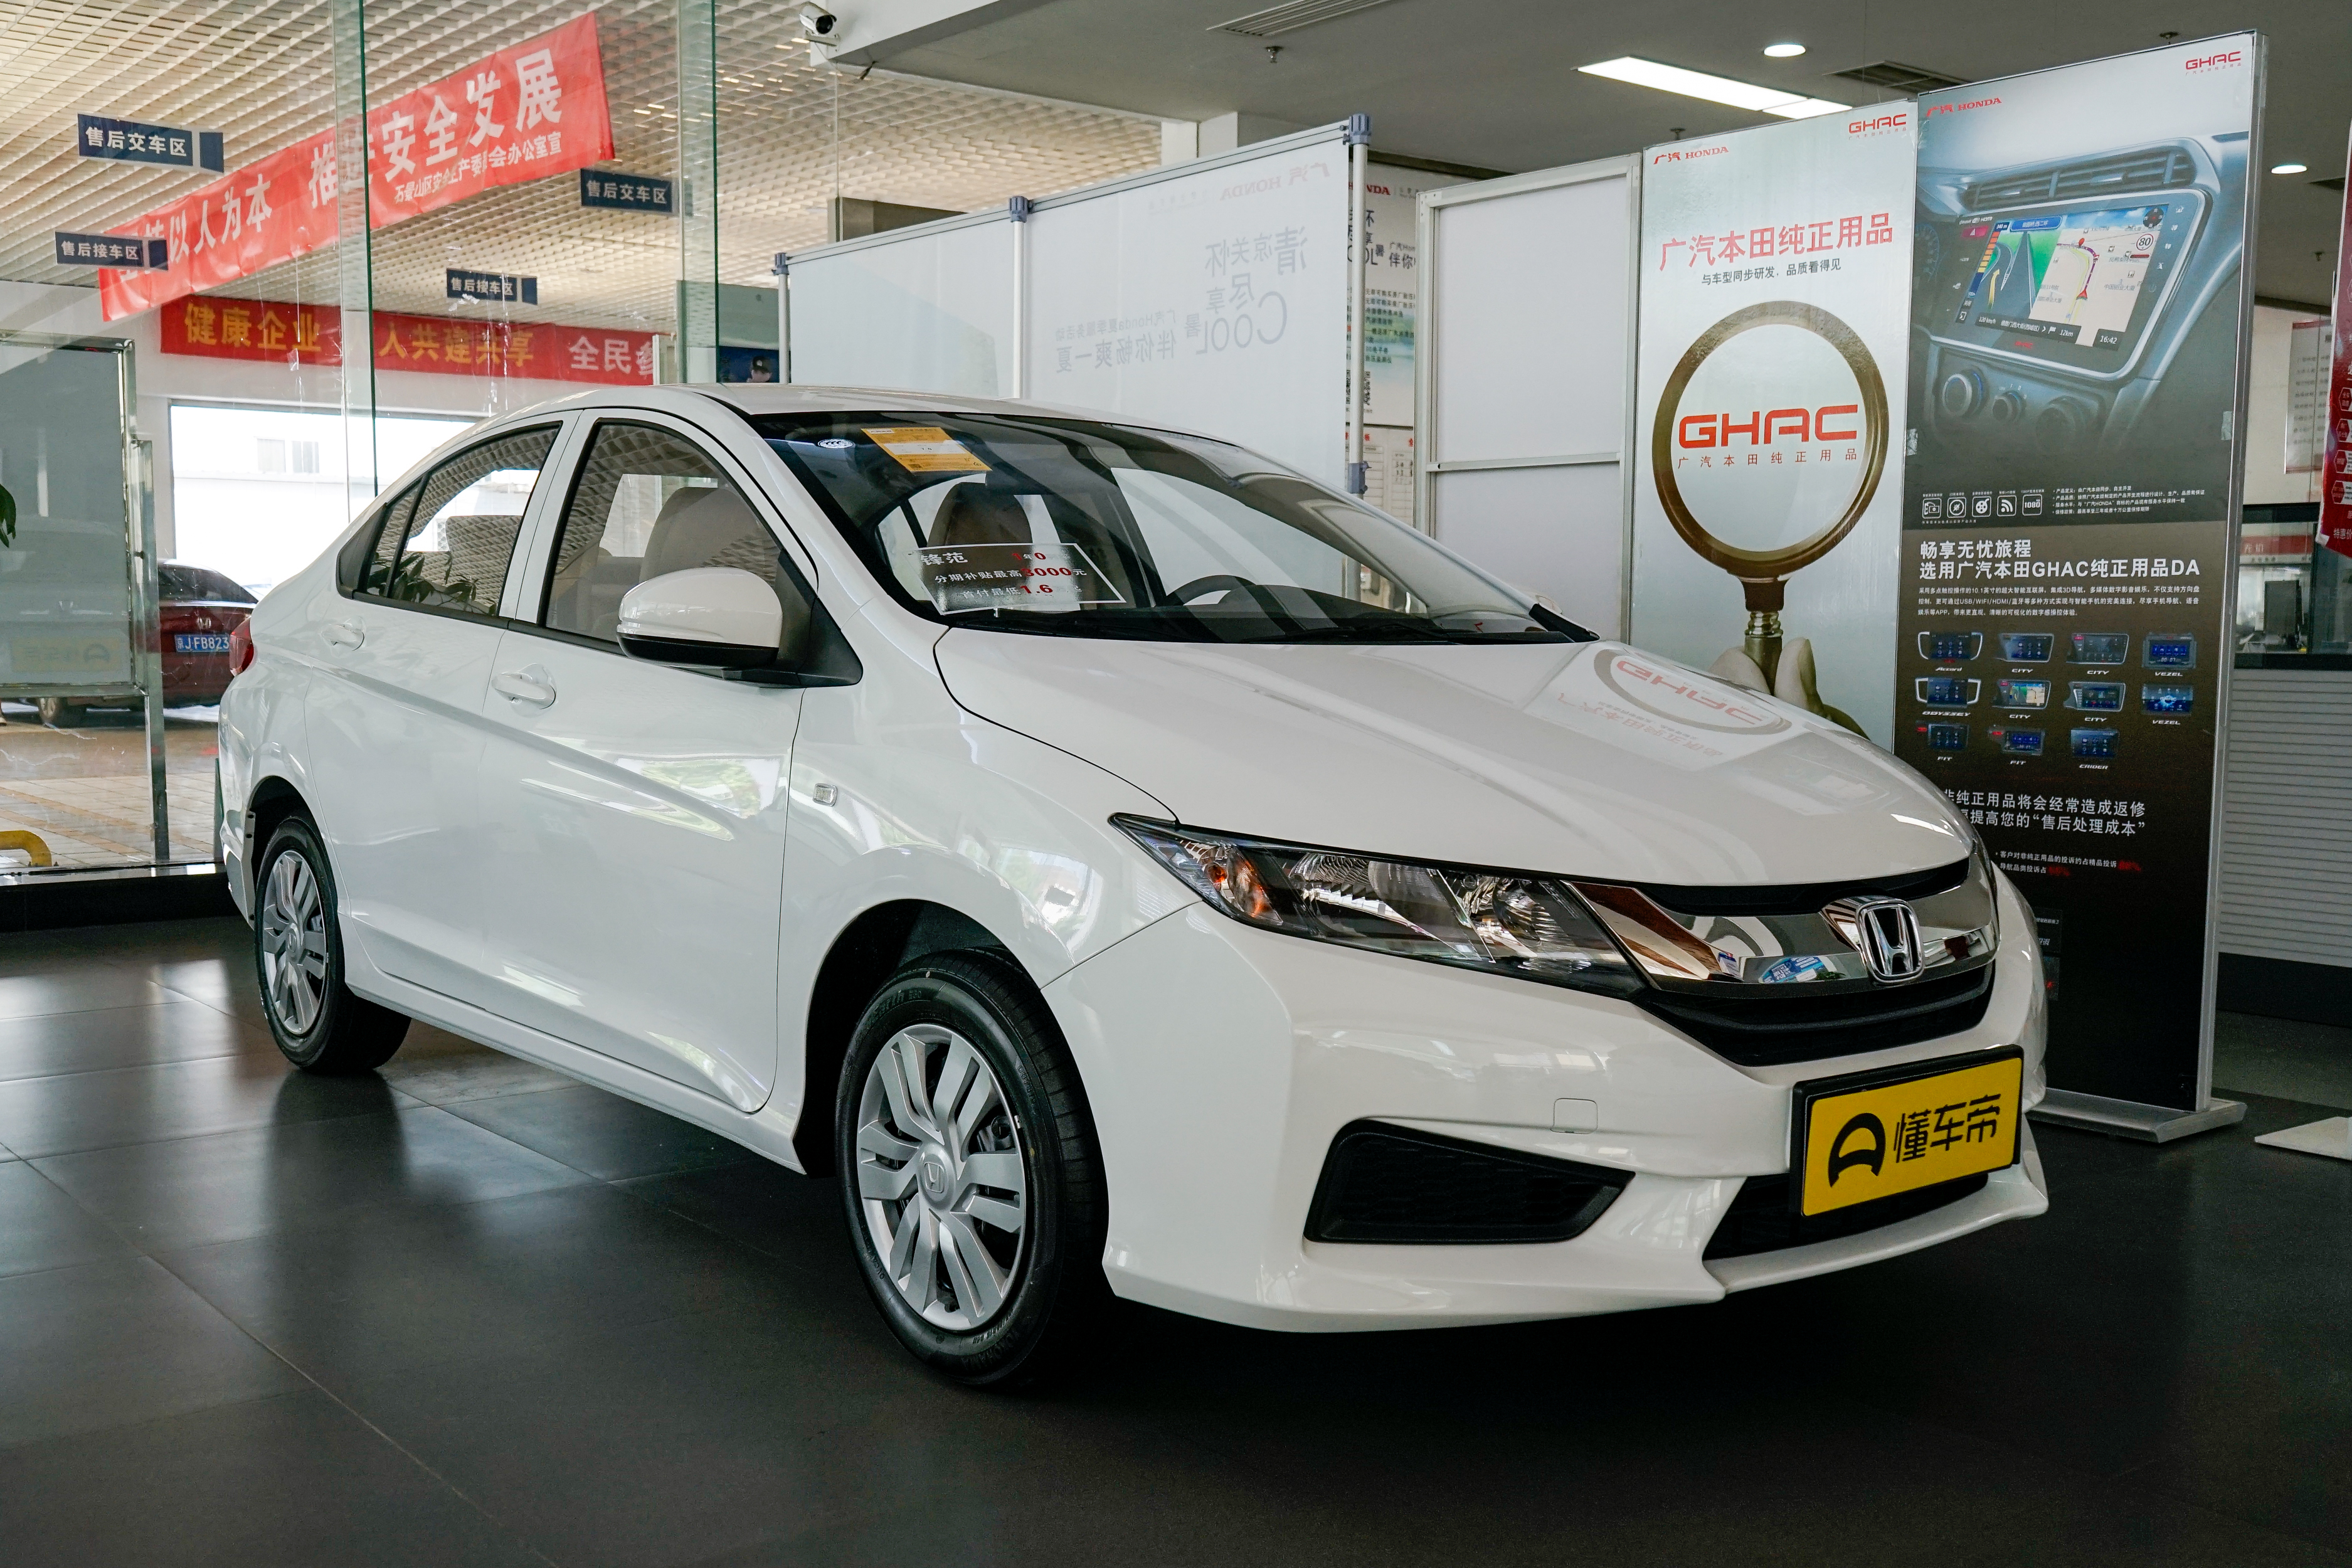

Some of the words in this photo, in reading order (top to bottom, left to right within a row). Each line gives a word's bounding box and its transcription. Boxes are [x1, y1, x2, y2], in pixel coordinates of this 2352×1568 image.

[2185, 51, 2242, 70] GHAC
[1957, 97, 2002, 111] HONDA
[1848, 113, 1907, 134] GHAC
[86, 127, 187, 157] 售后交车区
[1653, 151, 1682, 165] 广汽
[1685, 146, 1729, 160] HONDA
[586, 180, 667, 204] 售后交车区
[61, 241, 142, 260] 售后接车区
[1660, 213, 1893, 271] 广汽本田纯正用品
[2139, 237, 2151, 246] 80
[1702, 258, 1841, 286] 与车型同步研发，品质看得见
[450, 276, 514, 297] 售后接车区
[184, 304, 321, 352] 健康企业
[2060, 329, 2074, 337] 12km
[2099, 335, 2117, 345] 16:42
[1678, 405, 1858, 449] GHAC
[1678, 448, 1857, 469] 广汽本田纯正用品
[921, 553, 968, 566] 锋范
[1920, 539, 2032, 559] 畅享无忧旅程
[935, 566, 1087, 583] 分期补贴最高3000元
[1919, 558, 2200, 580] 选用广汽本田GHAC纯正用品DA
[1893, 1094, 2001, 1163] 懂车帝
